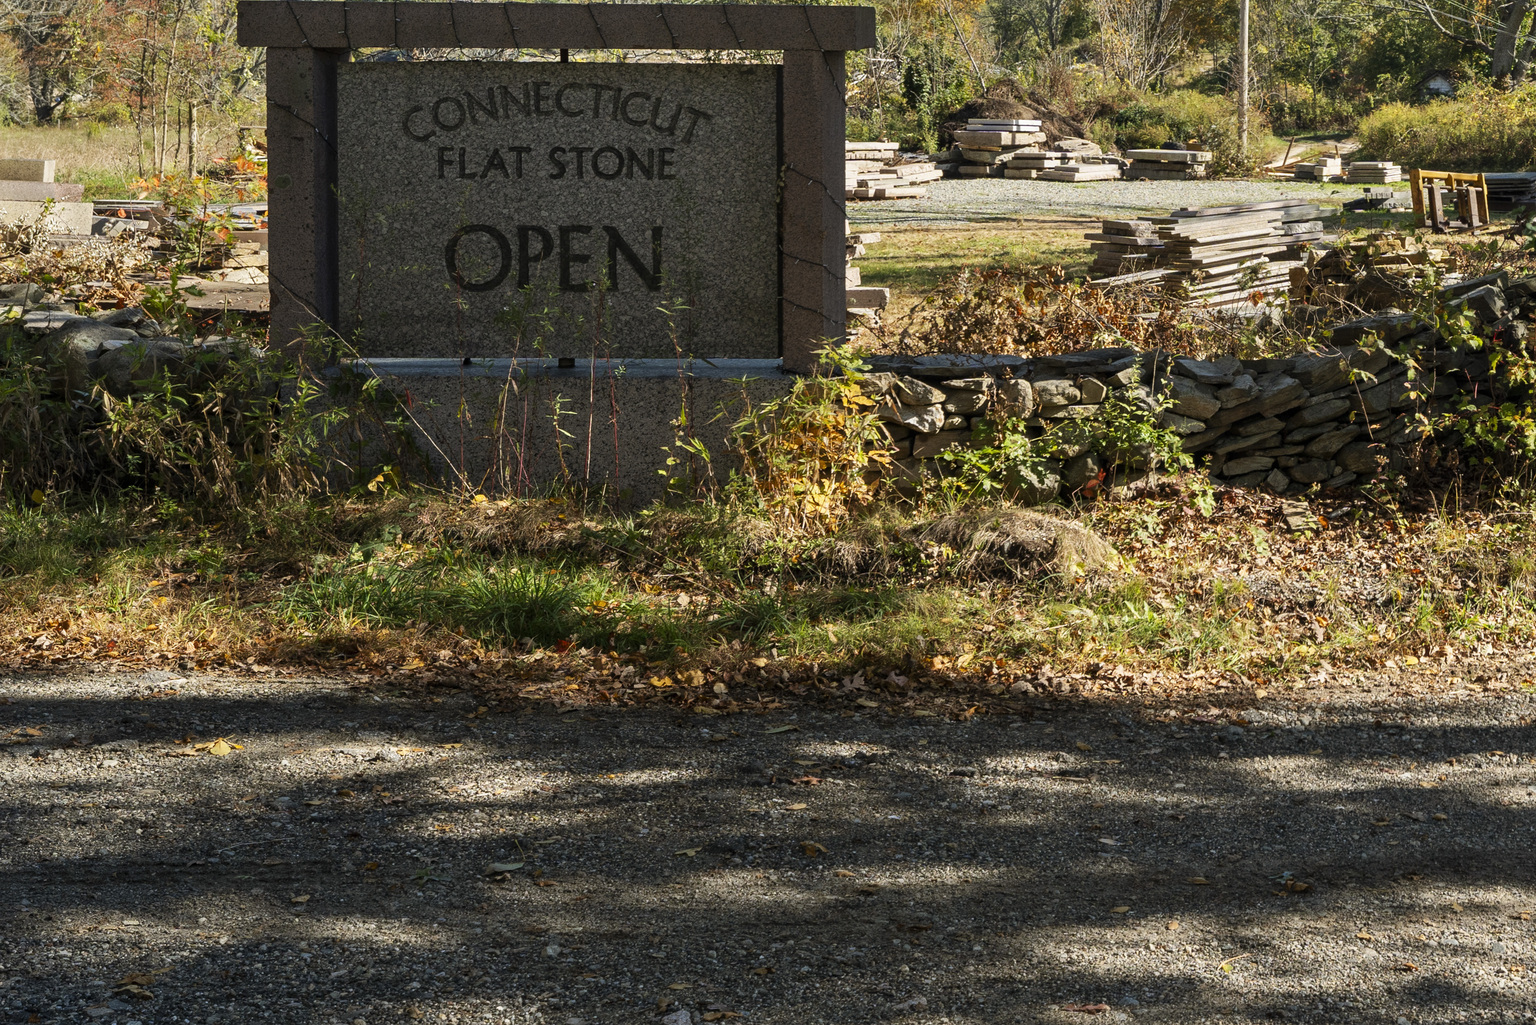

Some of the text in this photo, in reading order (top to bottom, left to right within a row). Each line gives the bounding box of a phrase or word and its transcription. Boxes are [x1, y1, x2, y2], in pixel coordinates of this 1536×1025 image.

[402, 81, 713, 145] CONNECTICUT
[437, 146, 677, 180] FLAT STONE
[445, 224, 663, 292] OPEN
